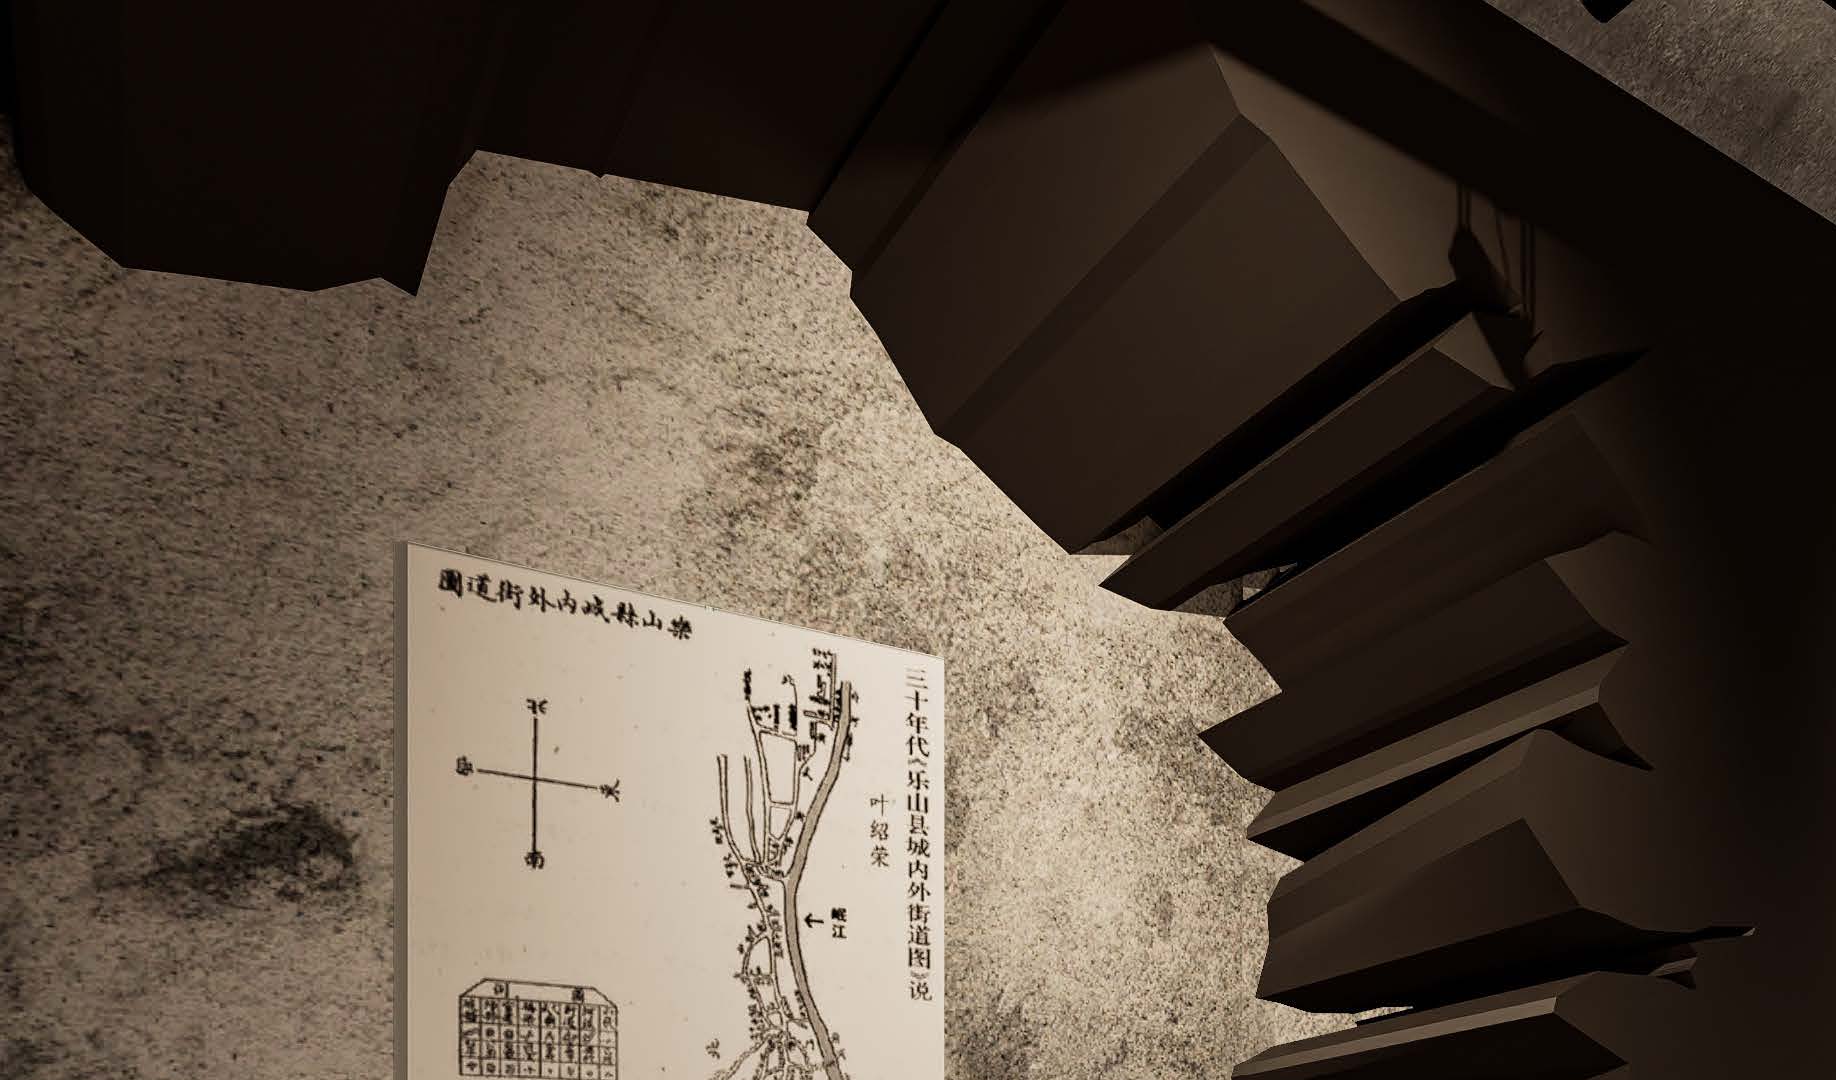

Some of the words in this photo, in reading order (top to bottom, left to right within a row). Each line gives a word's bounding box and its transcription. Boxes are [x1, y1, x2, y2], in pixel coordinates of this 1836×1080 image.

[870, 793, 890, 869] 叶绍荣
[831, 907, 848, 940] 岷江
